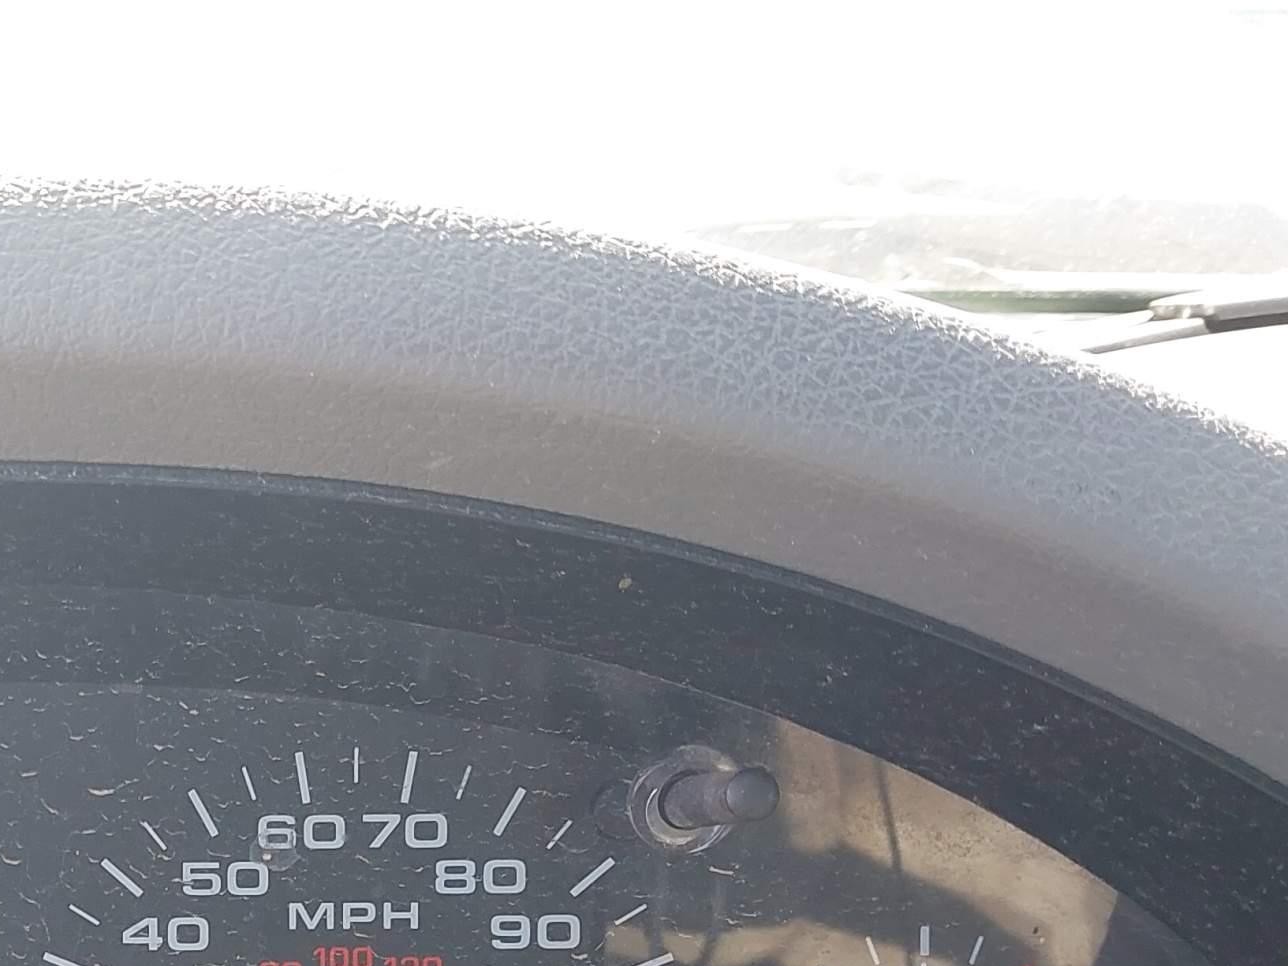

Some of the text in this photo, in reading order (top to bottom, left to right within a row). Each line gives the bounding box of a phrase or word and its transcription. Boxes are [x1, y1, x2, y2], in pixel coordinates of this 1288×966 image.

[257, 814, 345, 849] 60
[361, 813, 448, 848] 70
[180, 861, 270, 896] 50
[434, 858, 527, 895] 80
[121, 916, 211, 951] 40
[288, 902, 419, 930] MPH
[490, 914, 581, 950] 90
